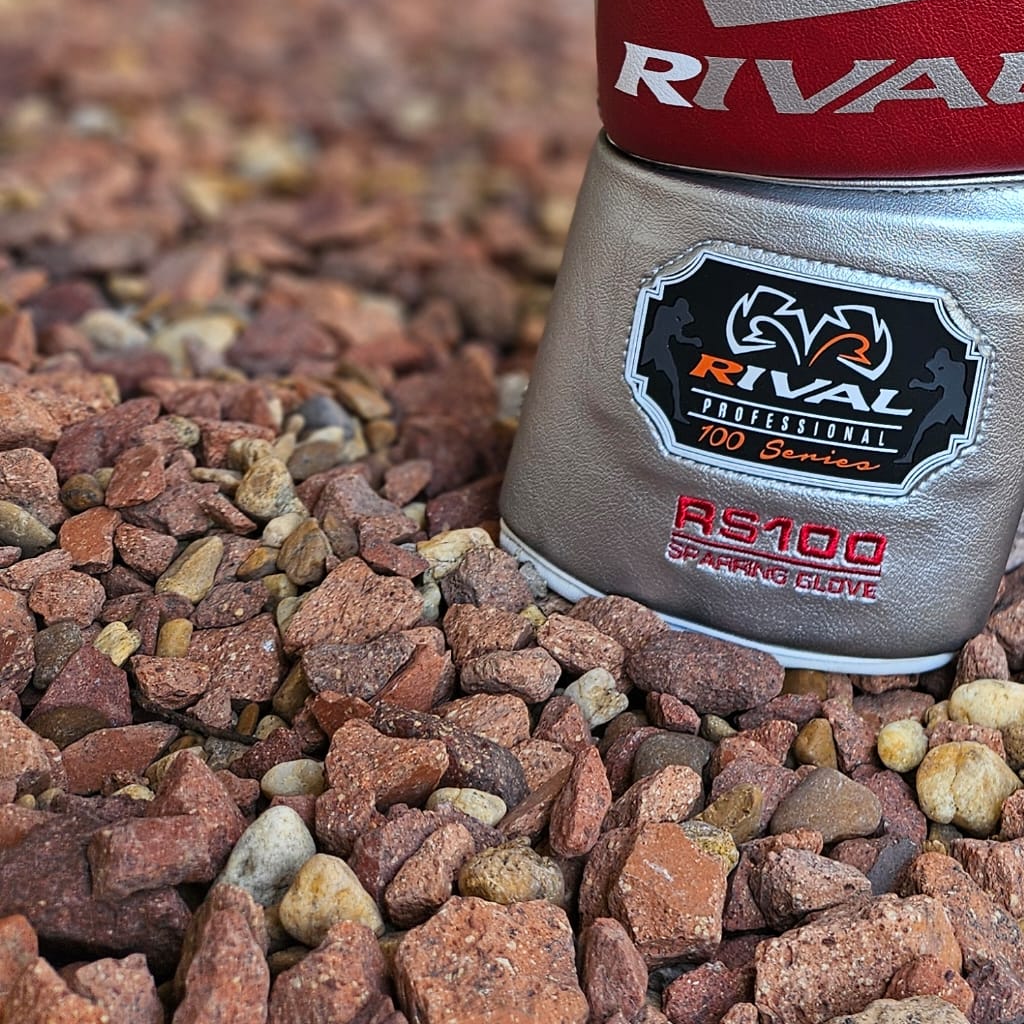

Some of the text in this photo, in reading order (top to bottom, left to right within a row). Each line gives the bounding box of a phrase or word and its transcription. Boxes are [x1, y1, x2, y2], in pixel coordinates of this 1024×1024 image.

[689, 354, 913, 417] RIVAL
[697, 424, 881, 473] 100 Series
[702, 398, 885, 447] PROFESSIONAL
[674, 495, 887, 566] RS100
[667, 541, 878, 600] SPARRING GLOVE
